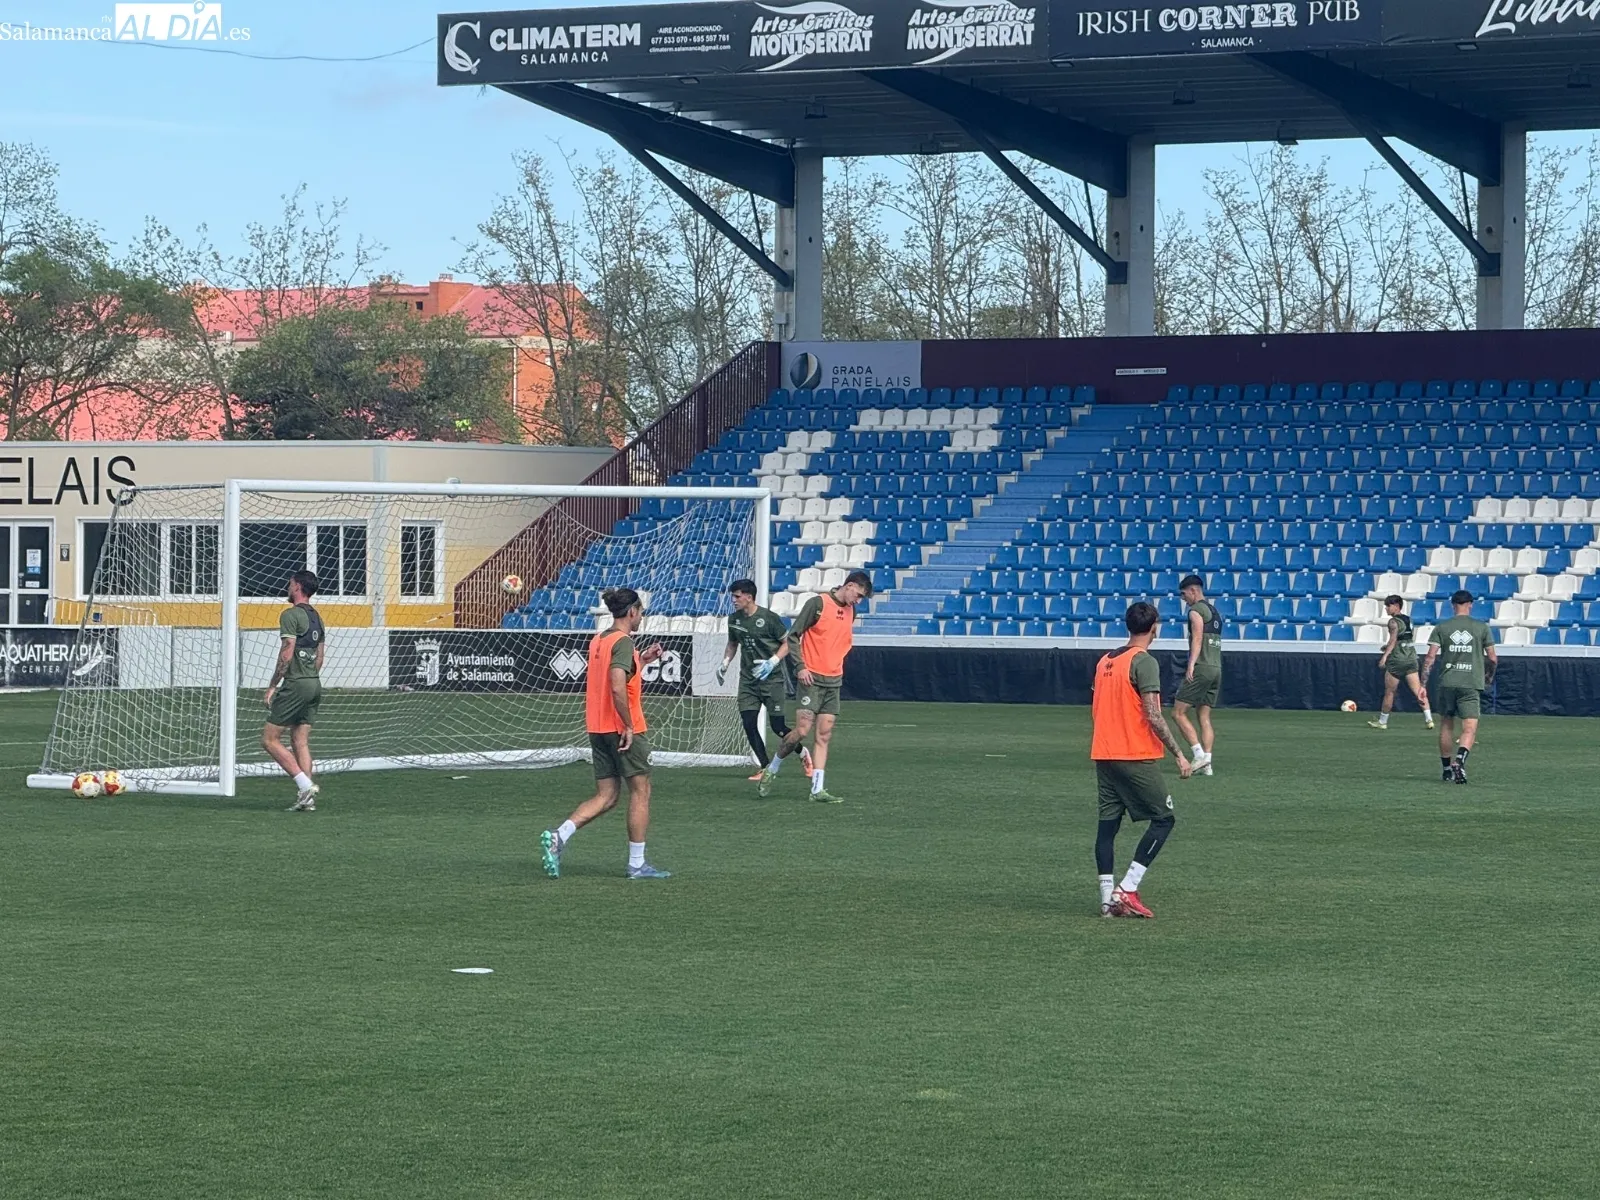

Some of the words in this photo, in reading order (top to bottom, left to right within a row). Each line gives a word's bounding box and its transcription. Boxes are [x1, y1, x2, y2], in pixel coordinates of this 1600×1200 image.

[750, 15, 797, 33] Artes
[802, 10, 874, 31] Gráficas
[907, 8, 956, 26] Artes
[961, 3, 1036, 24] Gráficas
[1076, 10, 1152, 36] IRISH
[1158, 3, 1297, 32] CORNER
[1306, 0, 1360, 26] PUB
[489, 23, 641, 51] CLIMATERM
[651, 37, 662, 45] 677
[718, 34, 730, 42] 761
[749, 29, 873, 57] MONTSERRAT
[906, 22, 1035, 50] MONTSERRAT
[1201, 37, 1254, 48] SALAMANCA
[520, 51, 609, 65] SALAMANCA
[832, 366, 873, 375] GRADA
[831, 376, 911, 388] PANELAIS
[446, 653, 514, 667] Ayuntamiento
[21, 665, 60, 673] CENTER
[446, 668, 459, 681] de
[461, 668, 515, 682] Salamanca
